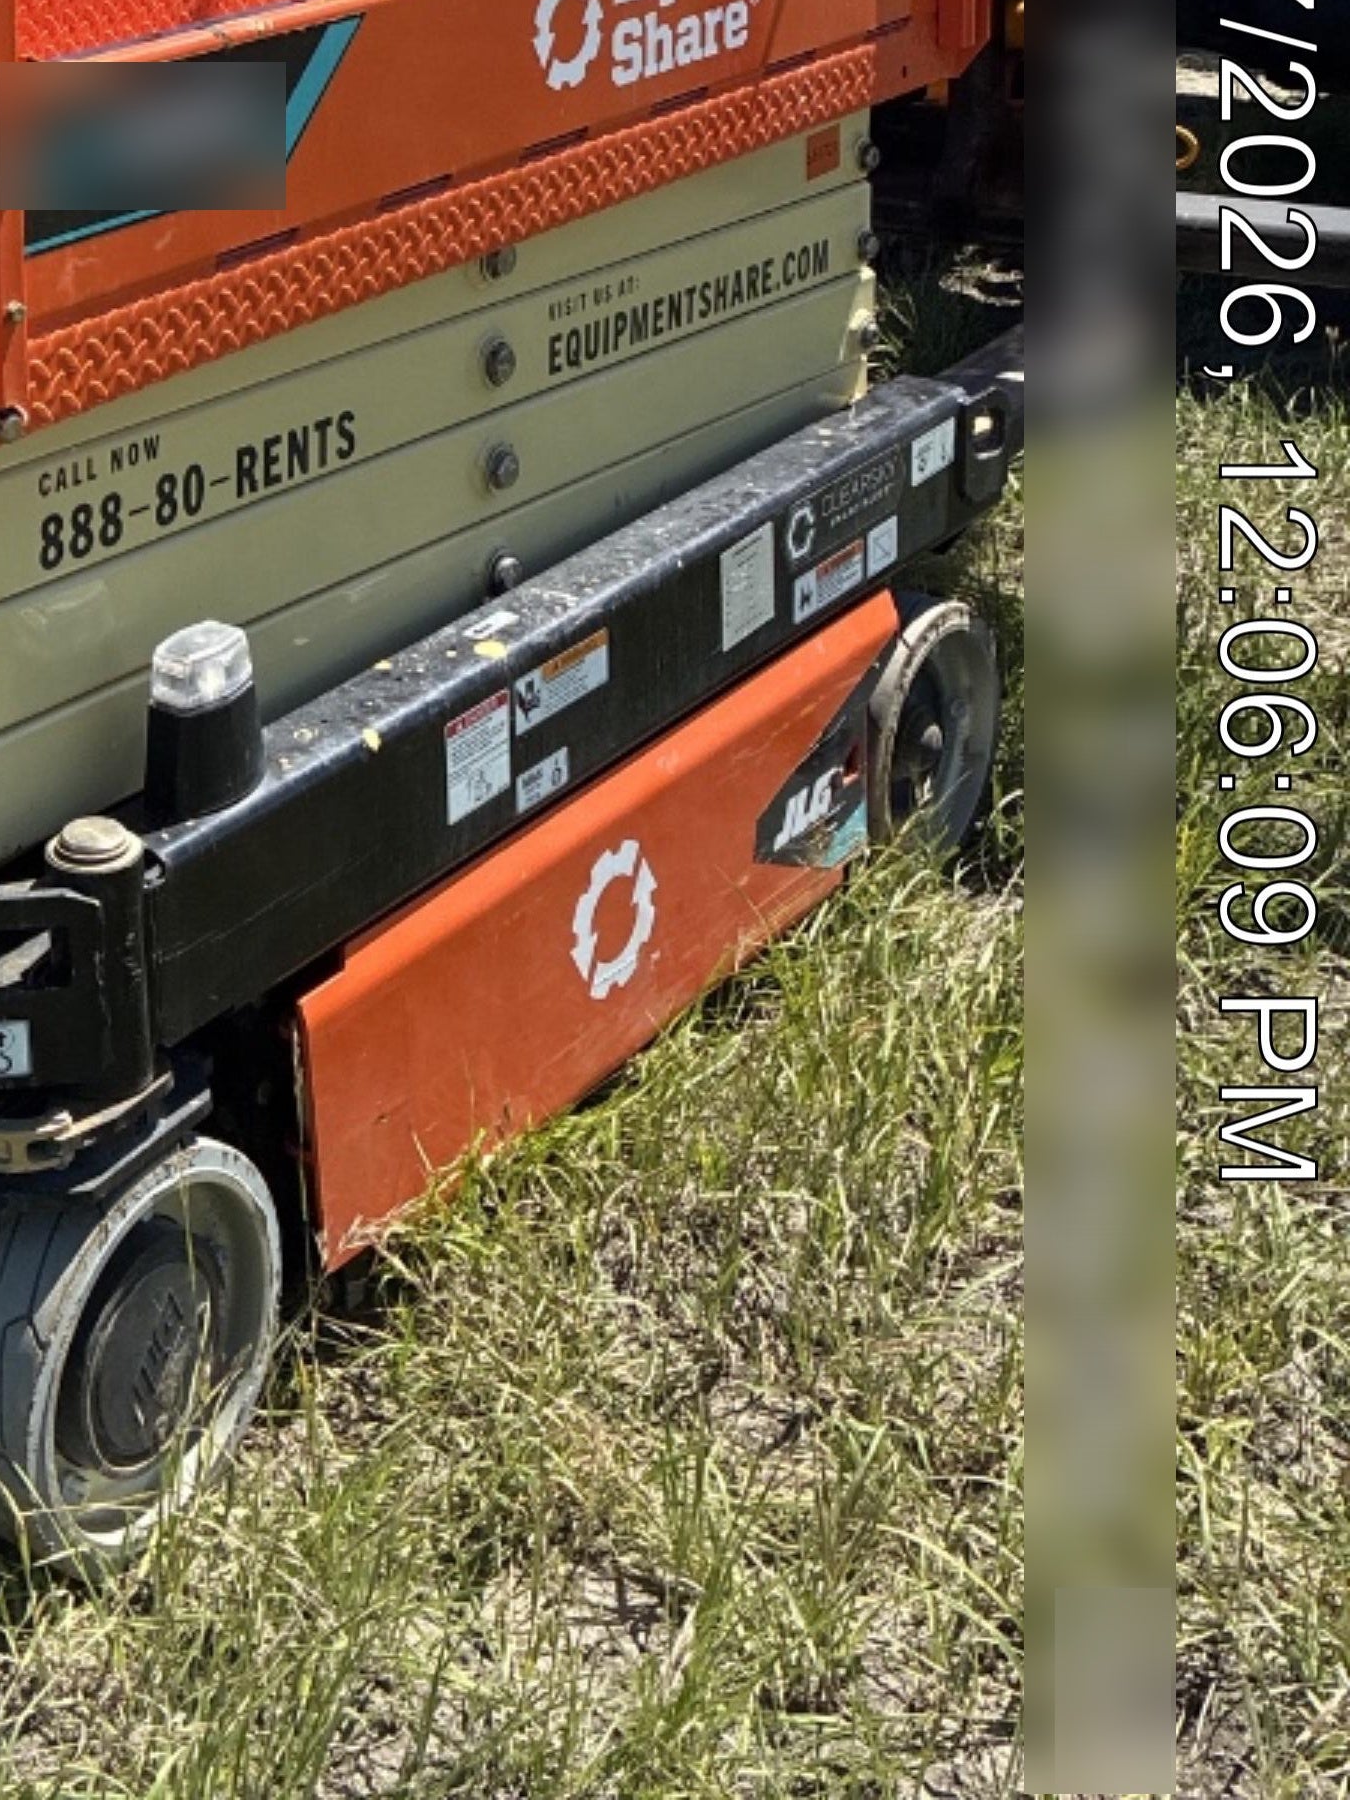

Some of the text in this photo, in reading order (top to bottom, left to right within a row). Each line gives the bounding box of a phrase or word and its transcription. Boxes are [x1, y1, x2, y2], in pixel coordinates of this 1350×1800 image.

[548, 275, 640, 321] VISIT US AT:
[548, 239, 830, 375] EQUIPMENTSHARE.COM
[37, 434, 161, 497] CALL NOW
[39, 410, 356, 571] 888-80-RENTS
